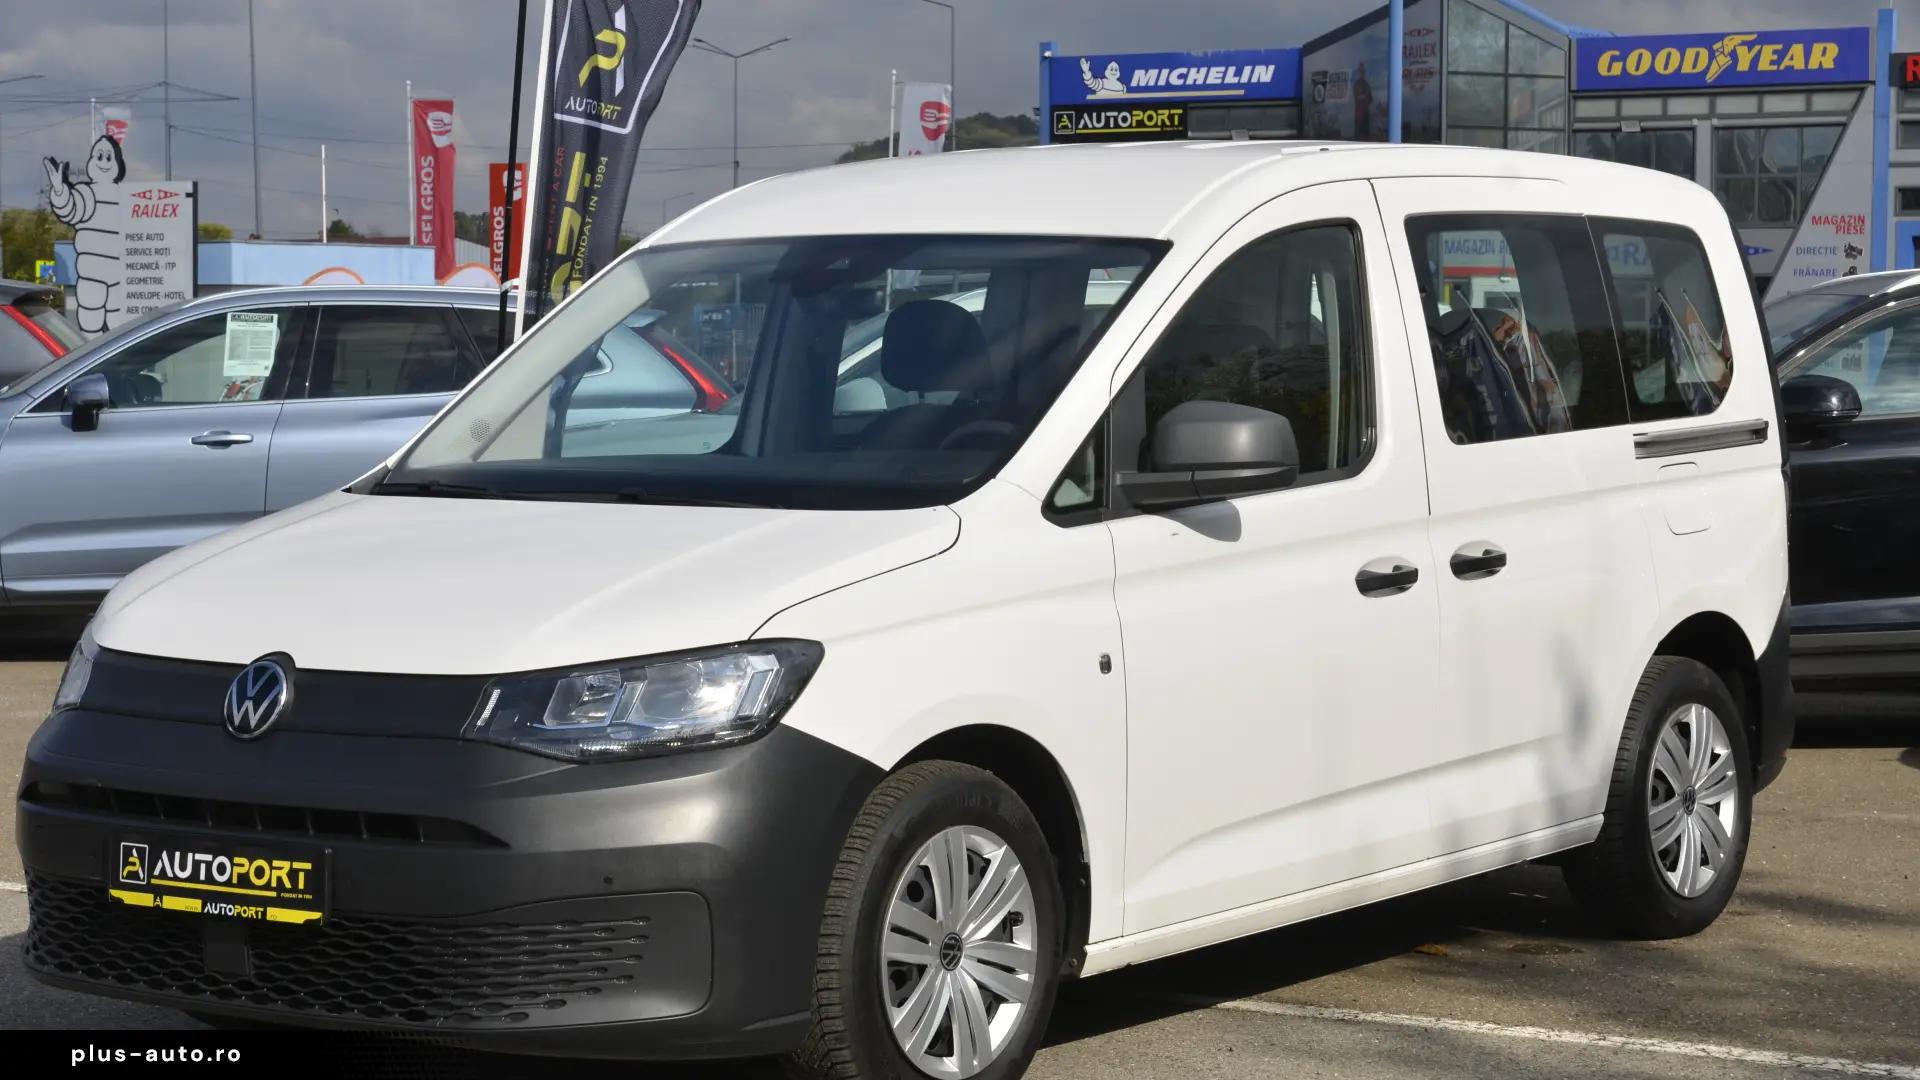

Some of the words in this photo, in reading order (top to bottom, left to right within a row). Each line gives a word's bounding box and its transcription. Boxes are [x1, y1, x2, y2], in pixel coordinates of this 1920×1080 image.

[1130, 65, 1275, 87] MICHELIN
[1078, 109, 1183, 128] AUTOPORT
[554, 146, 566, 179] CAR
[593, 156, 609, 190] 1994
[553, 182, 560, 192] A
[421, 155, 435, 244] SELGROS
[588, 196, 599, 211] IN
[131, 203, 180, 218] RAILEX
[1811, 215, 1865, 226] MAGAZIN
[125, 233, 144, 241] PIESE
[145, 233, 165, 241] AUTO
[1835, 225, 1865, 235] PIESE
[125, 248, 153, 256] SERVICE
[572, 215, 593, 278] FONDAT
[1444, 239, 1495, 254] MAGAZIN
[165, 262, 176, 271] ITP
[126, 277, 164, 285] GEOMETRIE
[126, 292, 160, 300] ANVELOPE
[164, 292, 186, 300] HOTEL
[126, 306, 139, 315] AER
[153, 850, 312, 890] AUTOPORT
[203, 902, 264, 919] AUTOPORT
